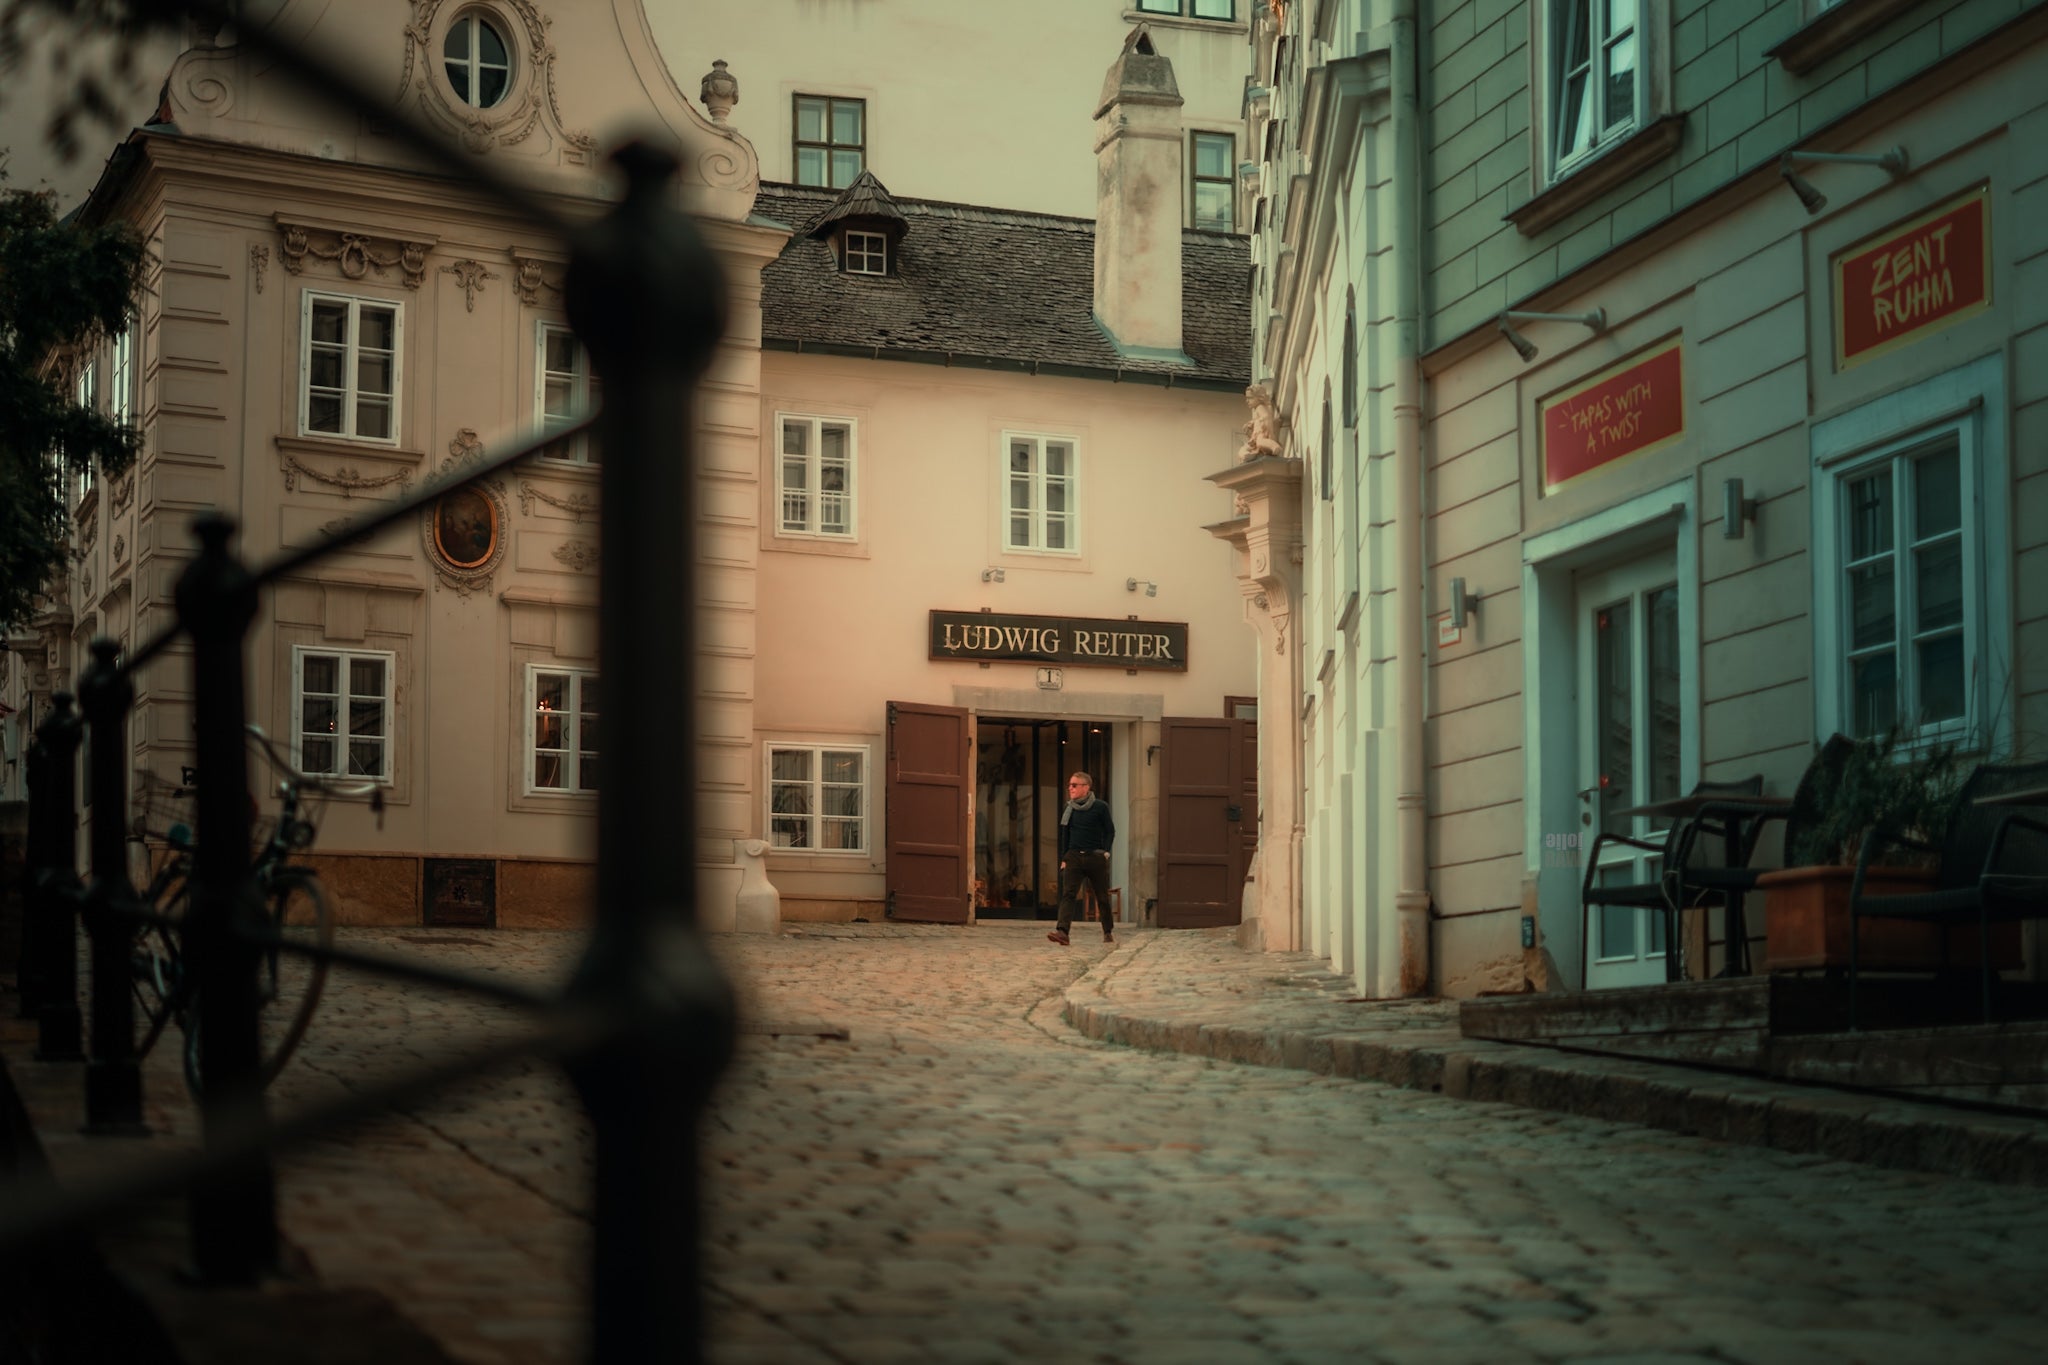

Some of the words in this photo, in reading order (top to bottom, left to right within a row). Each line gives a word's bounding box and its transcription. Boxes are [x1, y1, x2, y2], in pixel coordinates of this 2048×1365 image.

[1872, 222, 1953, 296] ZENT
[1874, 267, 1954, 334] RUHM
[1571, 395, 1612, 433] TAPAS
[1615, 380, 1652, 412] WITH
[1586, 431, 1597, 455] A
[1600, 410, 1643, 447] TWIST
[943, 623, 1060, 653] LUDWIG
[1073, 630, 1173, 659] REITER
